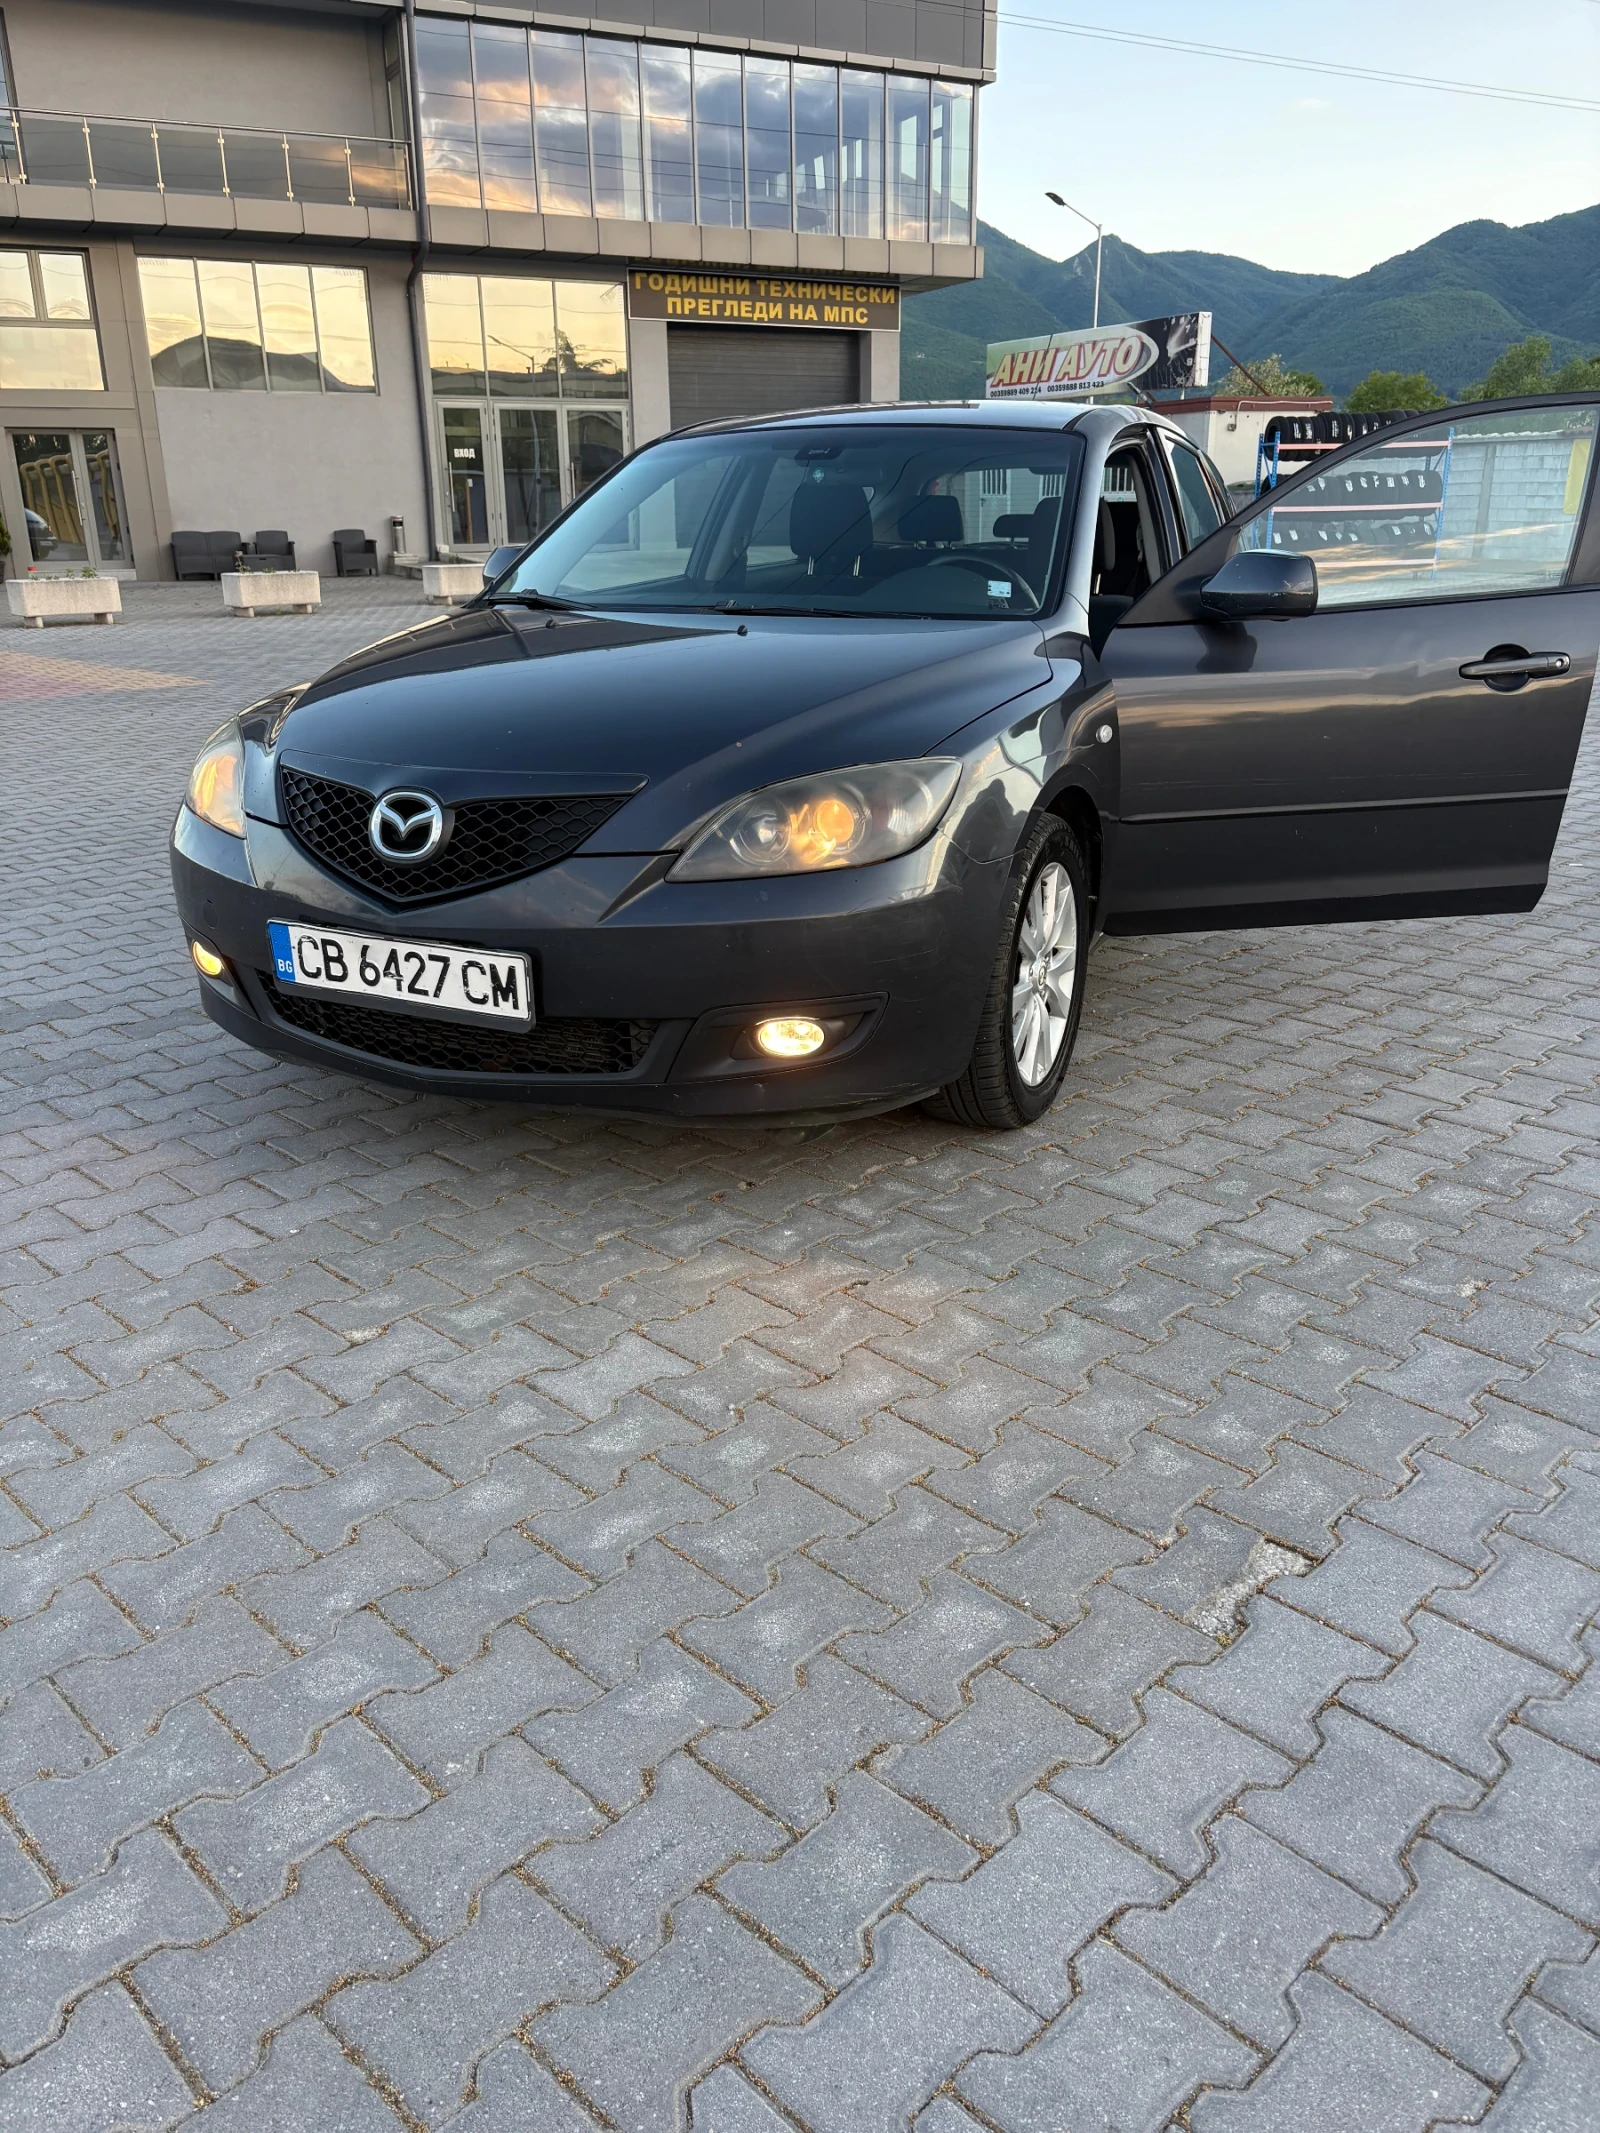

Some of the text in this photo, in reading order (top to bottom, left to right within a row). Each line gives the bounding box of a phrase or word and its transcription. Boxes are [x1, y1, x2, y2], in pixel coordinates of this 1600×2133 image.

[635, 272, 895, 304] ГОДИШНИ ТЕХНИЧЕСКИ
[667, 297, 869, 325] ПРЕГЛЕДИ НА МПС
[990, 335, 1143, 388] АНИ АУТО
[1018, 386, 1030, 395] 409
[1078, 381, 1091, 390] 813
[1091, 380, 1105, 389] 423
[453, 448, 476, 460] ВХОД
[278, 959, 293, 974] BG
[297, 934, 520, 1010] CB 6427 CM
